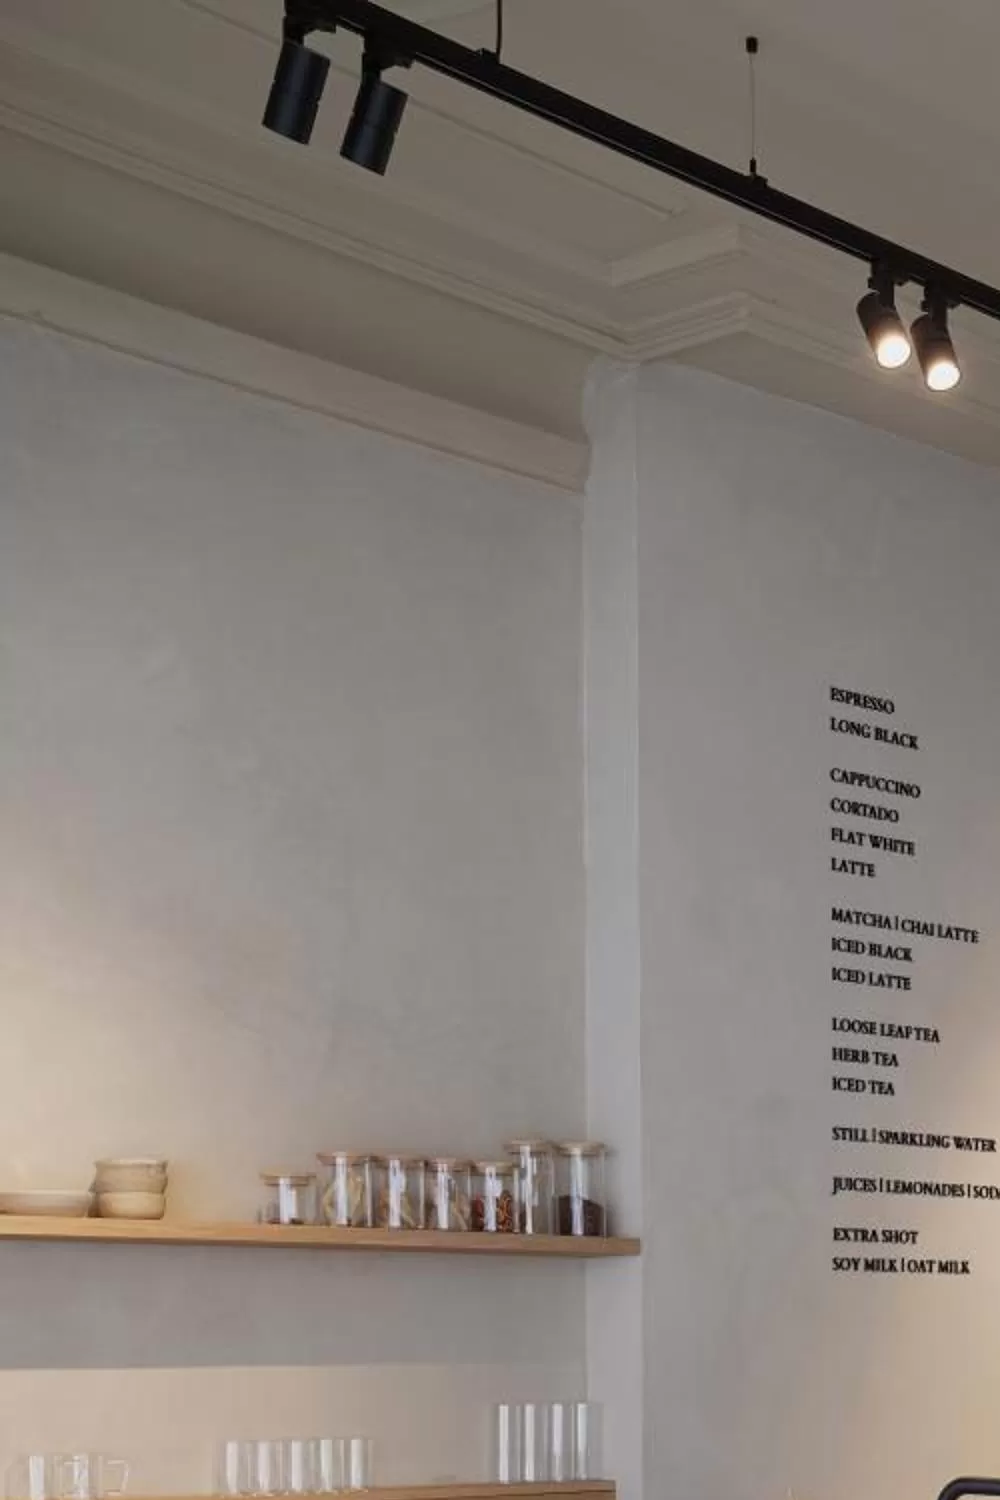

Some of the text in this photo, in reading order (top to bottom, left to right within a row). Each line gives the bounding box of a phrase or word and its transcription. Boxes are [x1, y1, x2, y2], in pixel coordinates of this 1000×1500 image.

[830, 687, 895, 714] ESPRESSO
[830, 717, 919, 750] LONG BLACK
[830, 768, 921, 798] CAPPUCCINO
[830, 797, 899, 823] CORTADO
[831, 827, 915, 856] FLAT WHITE
[831, 857, 875, 878] LATTE
[832, 907, 892, 930] MATCHA
[901, 919, 934, 936] CHAI
[937, 924, 979, 944] LATTE
[832, 937, 912, 962] ICED BLACK
[832, 967, 911, 990] ICED LATTE
[832, 1017, 940, 1043] LOOSE LEAF TEA
[832, 1047, 899, 1067] HERB TEA
[832, 1076, 895, 1096] ICED TEA
[832, 1126, 870, 1143] STILL
[878, 1130, 950, 1149] SPARKLING
[952, 1136, 996, 1152] WATER
[832, 1176, 878, 1195] JUICES
[886, 1180, 965, 1198] LEMONADES
[833, 1227, 919, 1244] EXTRA SHOT
[832, 1257, 861, 1272] SOY
[864, 1258, 898, 1273] MILK
[907, 1259, 936, 1274] OAT
[938, 1260, 970, 1275] MILK
